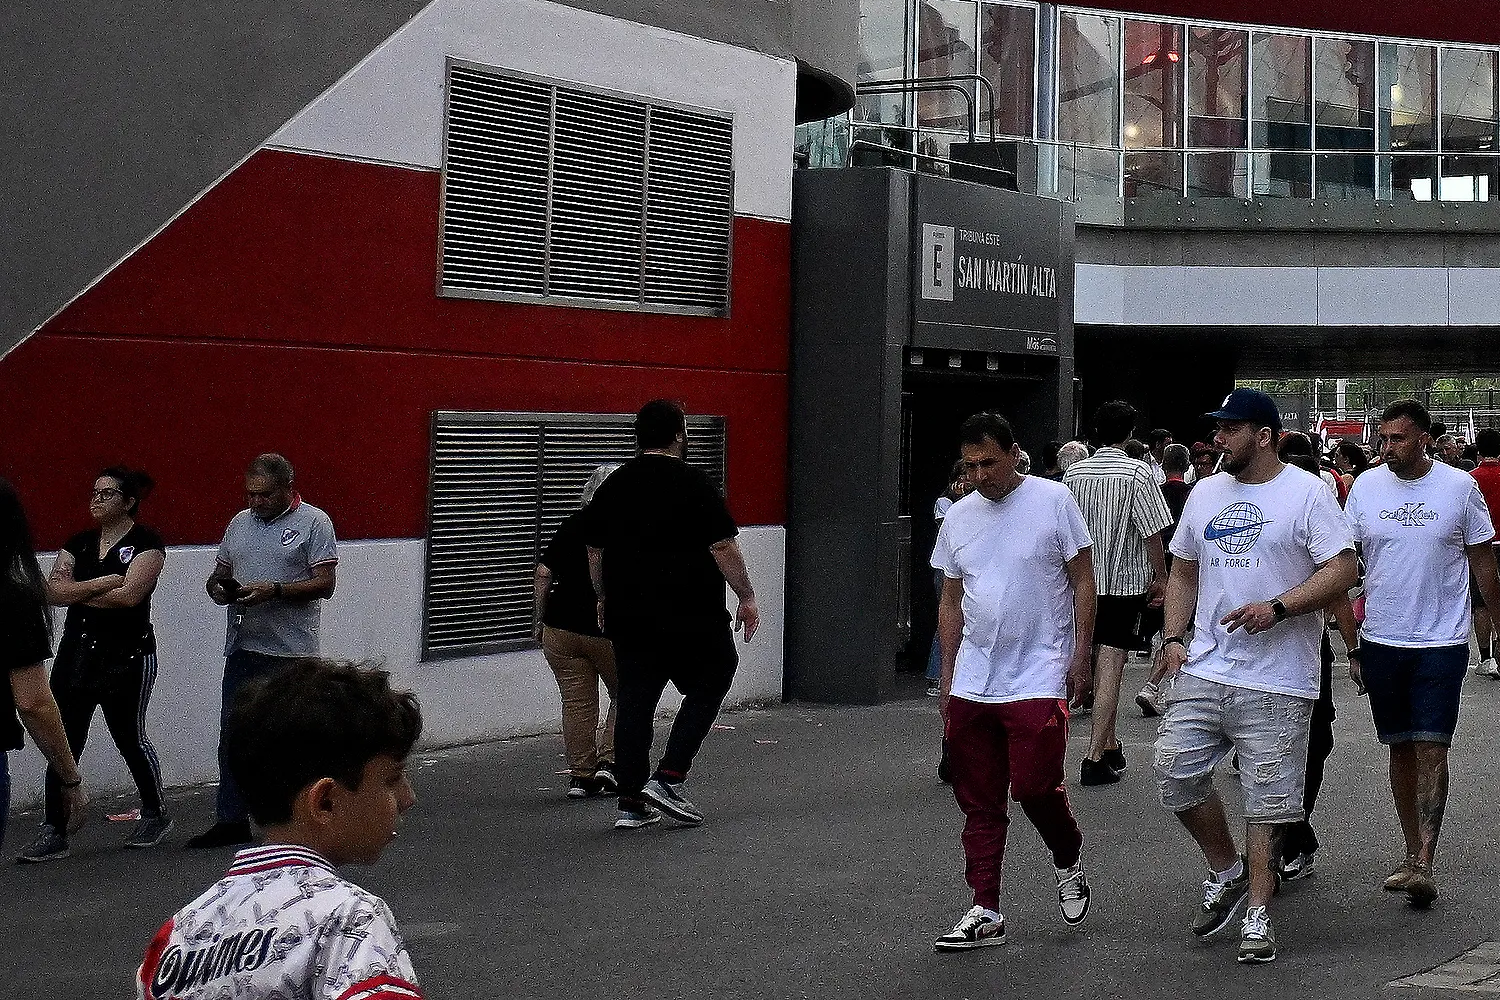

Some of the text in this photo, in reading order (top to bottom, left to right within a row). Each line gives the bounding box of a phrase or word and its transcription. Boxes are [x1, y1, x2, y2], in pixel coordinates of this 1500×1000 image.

[959, 229, 985, 244] TRIBUNA
[985, 233, 1001, 246] ESTE
[934, 244, 943, 287] E
[958, 254, 1057, 299] SAN MARTÍN ALTA
[1225, 557, 1251, 568] FORCE
[1255, 557, 1261, 568] 1
[150, 927, 279, 999] Quimes
